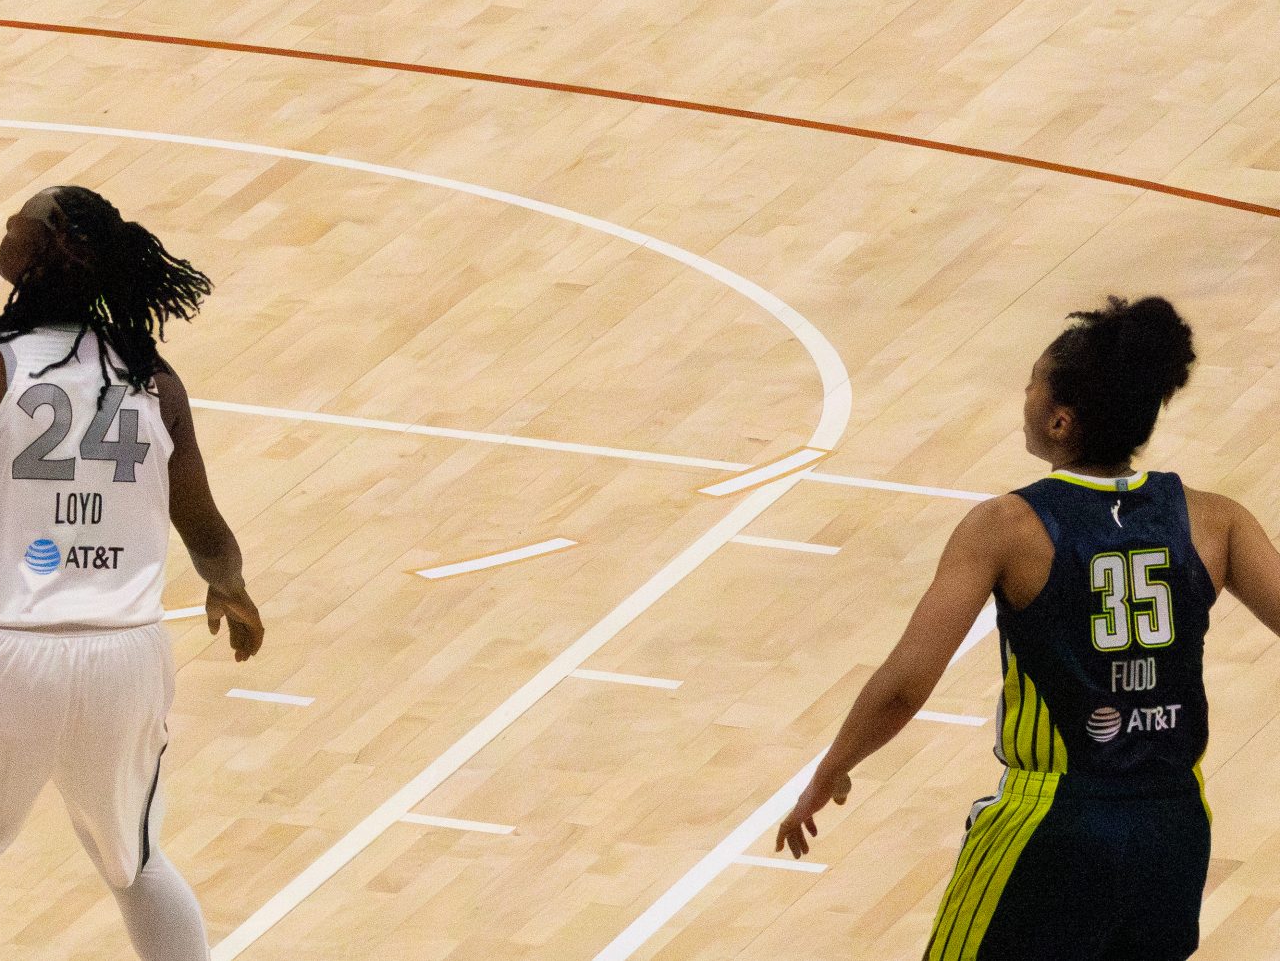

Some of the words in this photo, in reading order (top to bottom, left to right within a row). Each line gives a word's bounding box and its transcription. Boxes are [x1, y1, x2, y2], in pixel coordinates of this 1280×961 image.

[11, 382, 151, 483] 24
[55, 492, 103, 525] LOYD
[65, 546, 124, 570] AT&T
[1089, 547, 1175, 652] 35
[1111, 656, 1157, 693] FUDD
[1126, 704, 1182, 733] AT&T
